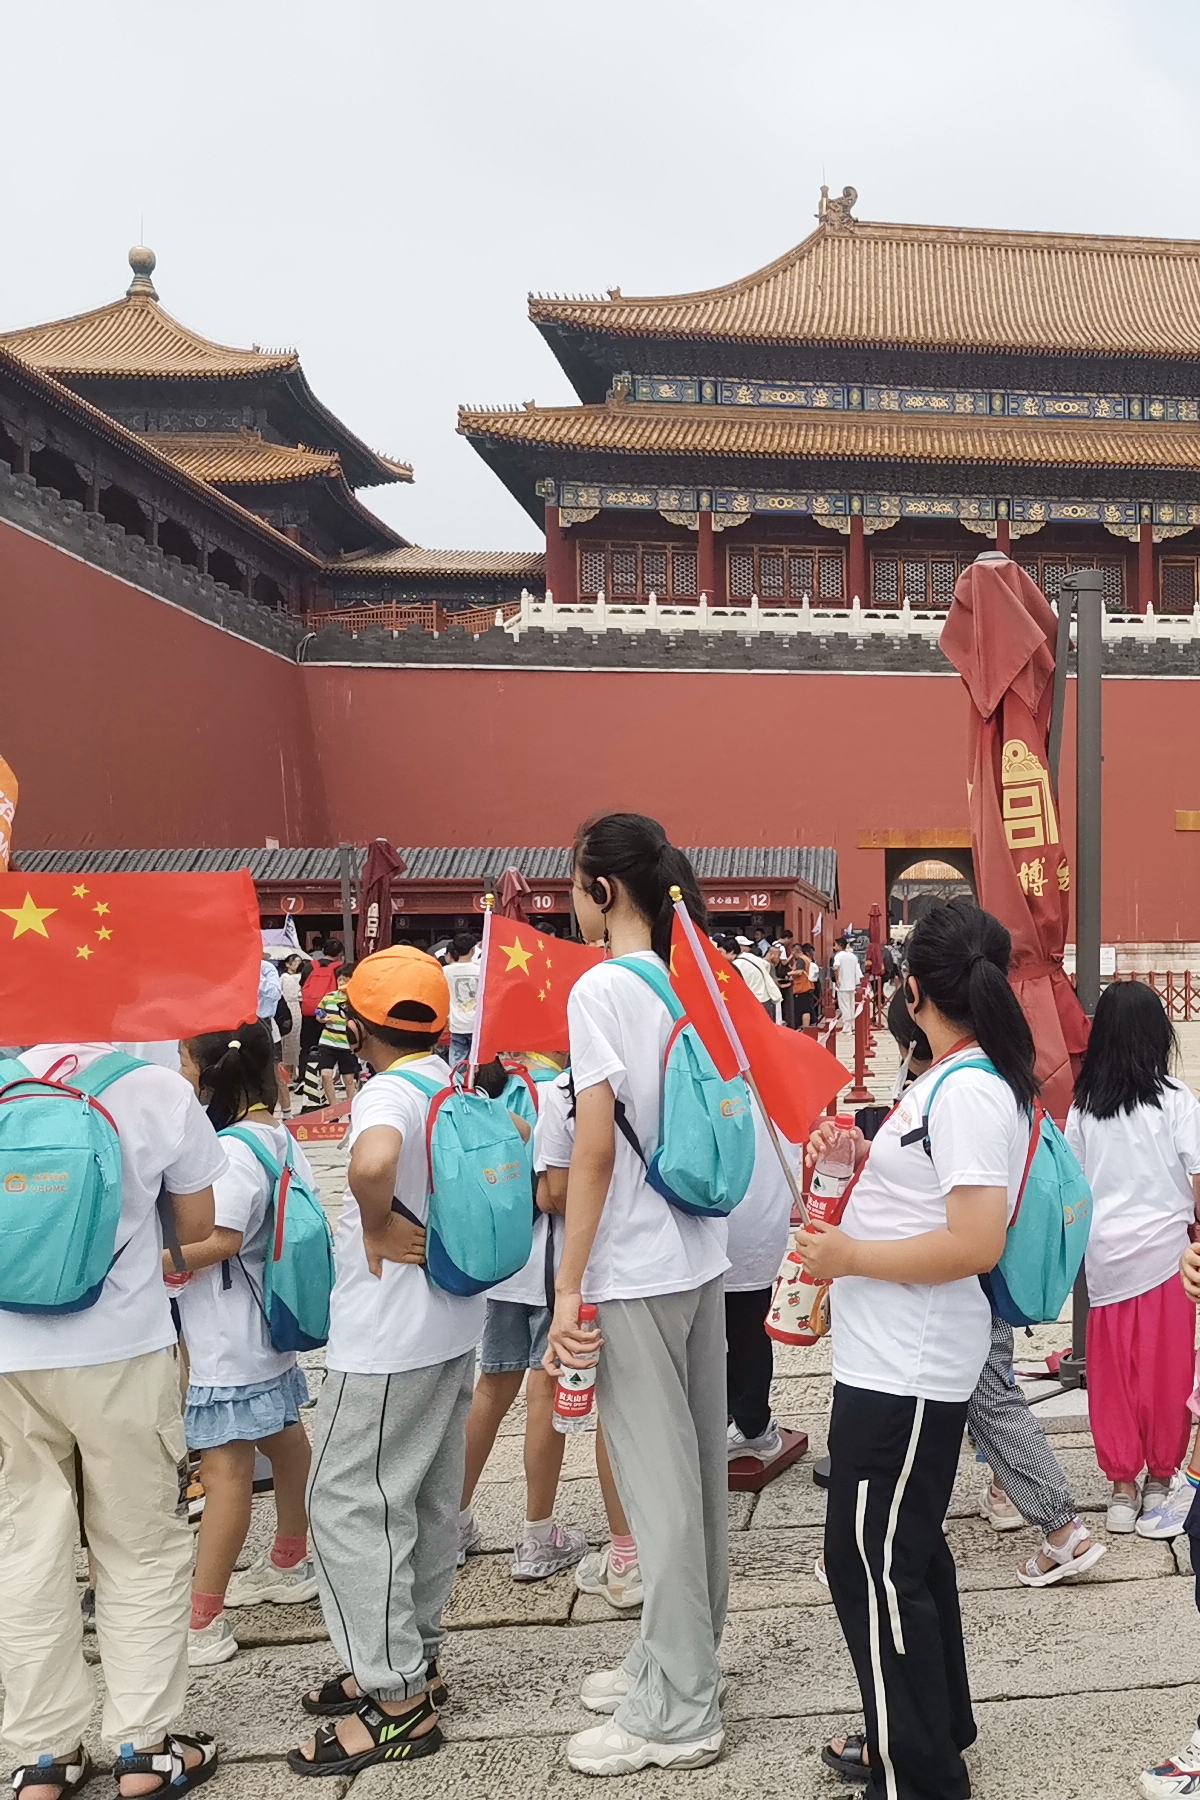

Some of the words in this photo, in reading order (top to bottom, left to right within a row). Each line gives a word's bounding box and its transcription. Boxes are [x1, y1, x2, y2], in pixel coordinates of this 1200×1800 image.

[286, 897, 297, 910] 7
[533, 895, 552, 909] 10
[750, 893, 768, 907] 12
